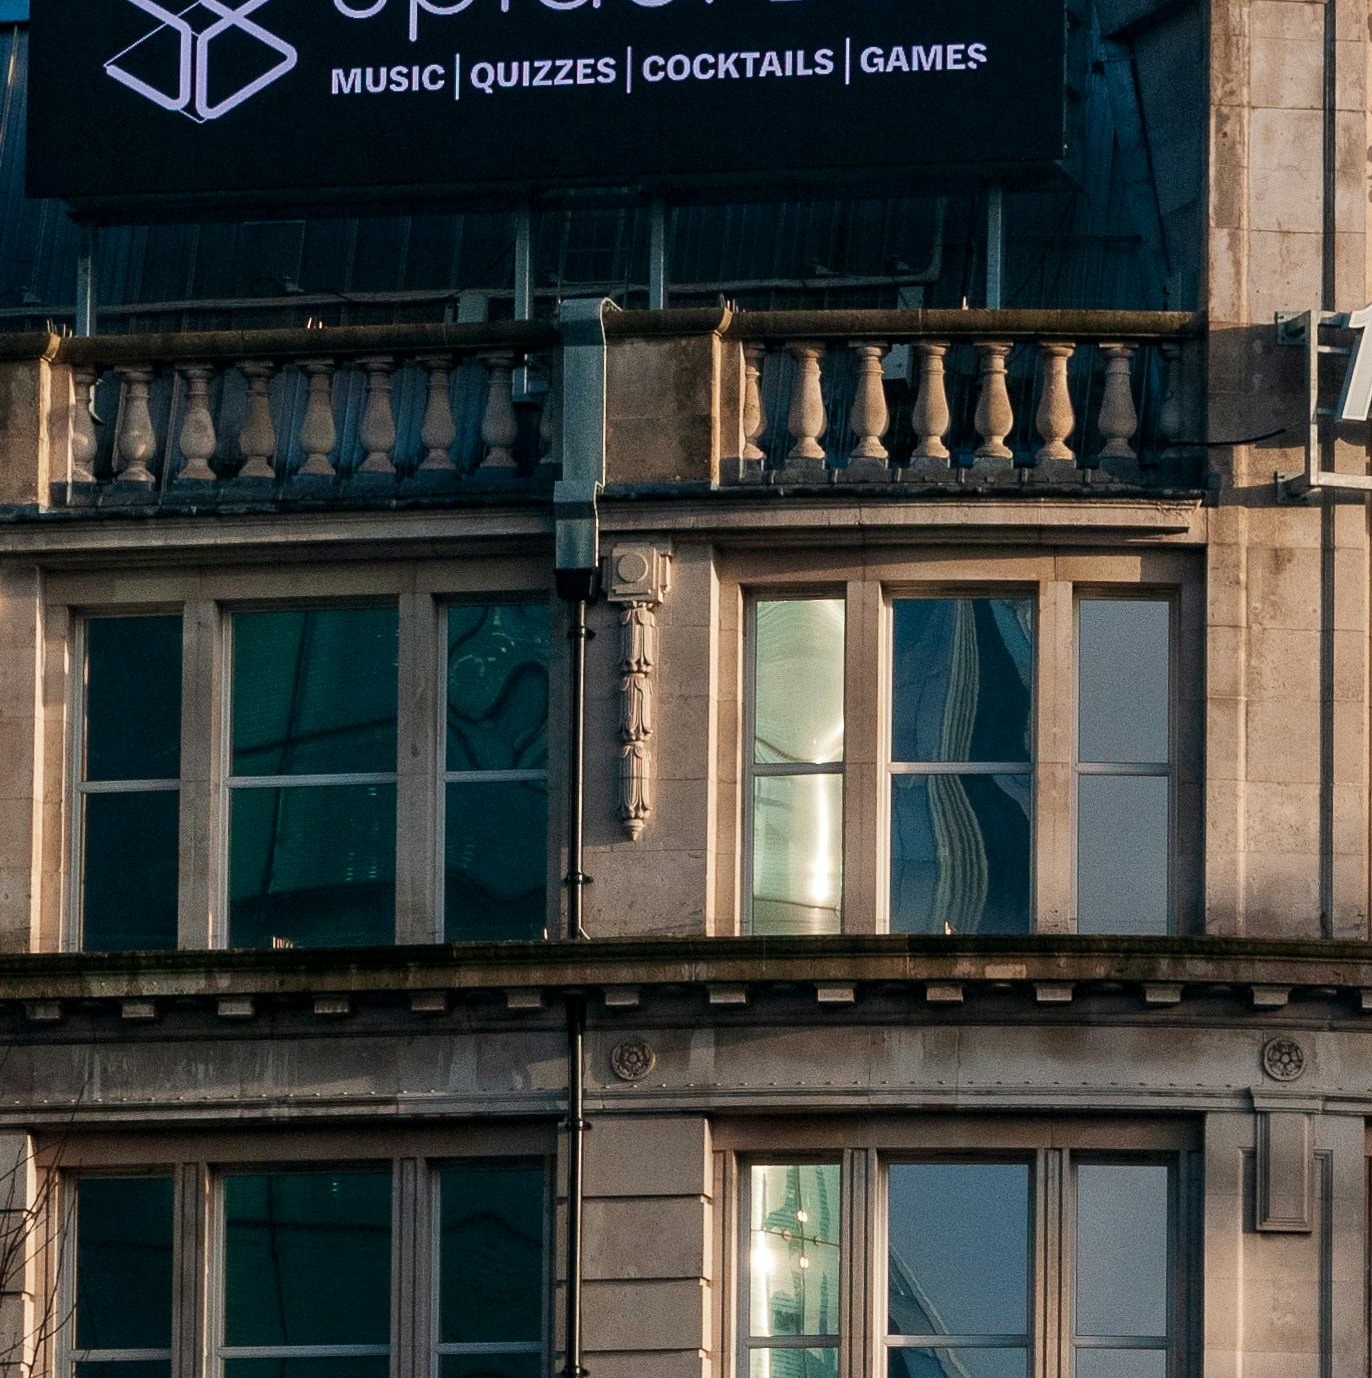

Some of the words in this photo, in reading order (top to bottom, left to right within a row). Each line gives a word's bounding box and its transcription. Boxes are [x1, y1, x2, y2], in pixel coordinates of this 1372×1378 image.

[331, 64, 445, 95] MUSIC
[470, 57, 617, 94] QUIZZES
[642, 48, 834, 82] COCKTAILS
[860, 42, 988, 73] GAMES
